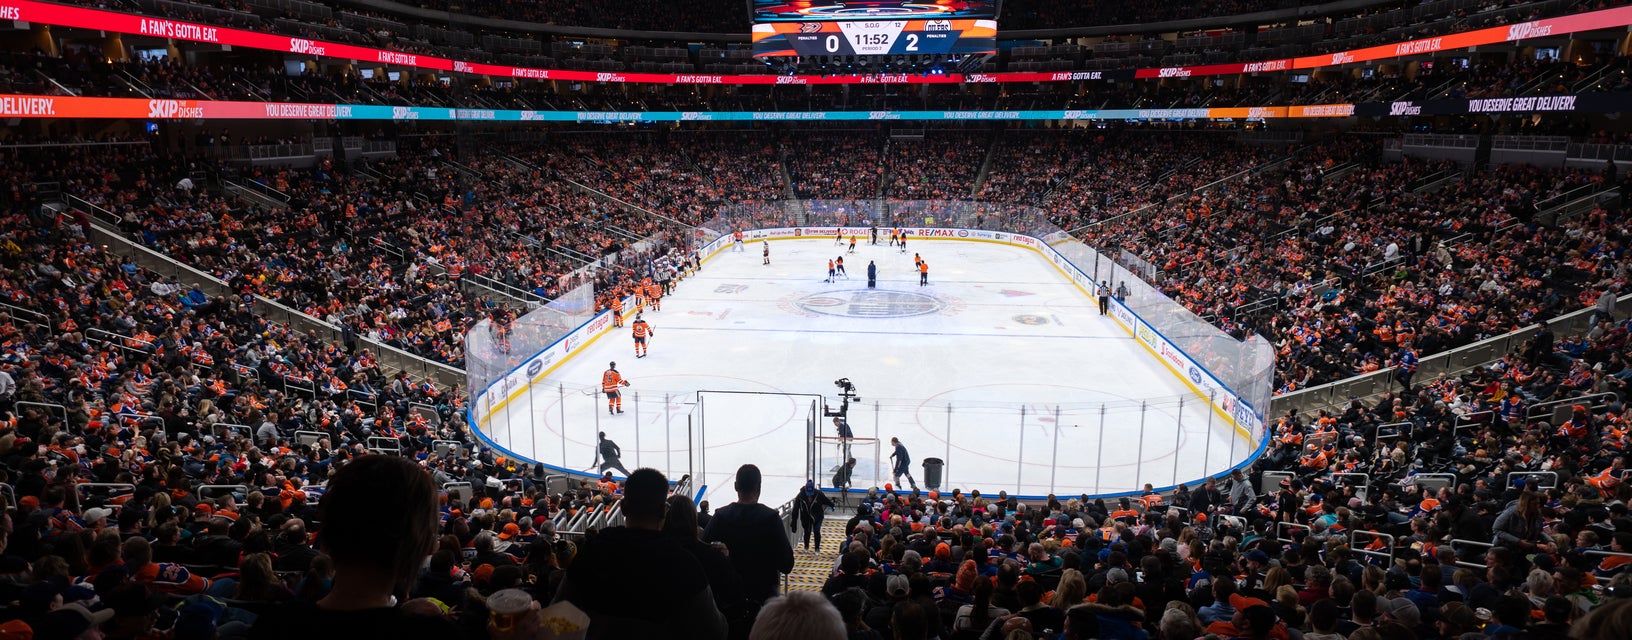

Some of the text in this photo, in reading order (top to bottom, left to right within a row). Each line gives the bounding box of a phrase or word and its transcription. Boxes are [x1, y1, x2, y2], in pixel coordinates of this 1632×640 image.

[140, 19, 218, 42] A FAN'S GOTTA EAT.
[1507, 22, 1531, 40] SKIP
[1530, 25, 1552, 38] DISHES
[826, 35, 839, 52] 0
[855, 34, 888, 44] 11:52
[906, 34, 918, 51] 2
[290, 38, 309, 53] SKIP
[309, 46, 325, 55] DISHES
[1396, 38, 1441, 55] A FAN'S GOTTA EAT.
[378, 52, 381, 60] A
[382, 52, 394, 63] FAN'S
[395, 54, 408, 63] GOTTA
[516, 69, 526, 77] FAN'S
[527, 69, 539, 78] GOTTA
[1159, 68, 1176, 77] SKIP
[1243, 64, 1247, 72] A
[1248, 63, 1261, 72] FAN'S
[1262, 62, 1276, 70] GOTTA
[597, 73, 611, 81] SKIP
[148, 99, 178, 118] SKIP
[179, 108, 203, 118] DISHES
[266, 104, 352, 117] YOU DESERVE GREAT DELIVERY.
[1390, 102, 1407, 115] SKIP
[1405, 106, 1421, 115] DISHES
[1468, 96, 1576, 112] YOU DESERVE GREAT DELIVERY.
[393, 107, 407, 119] SKIP
[681, 112, 697, 120] SKIP
[1166, 347, 1184, 369] Scotiabank
